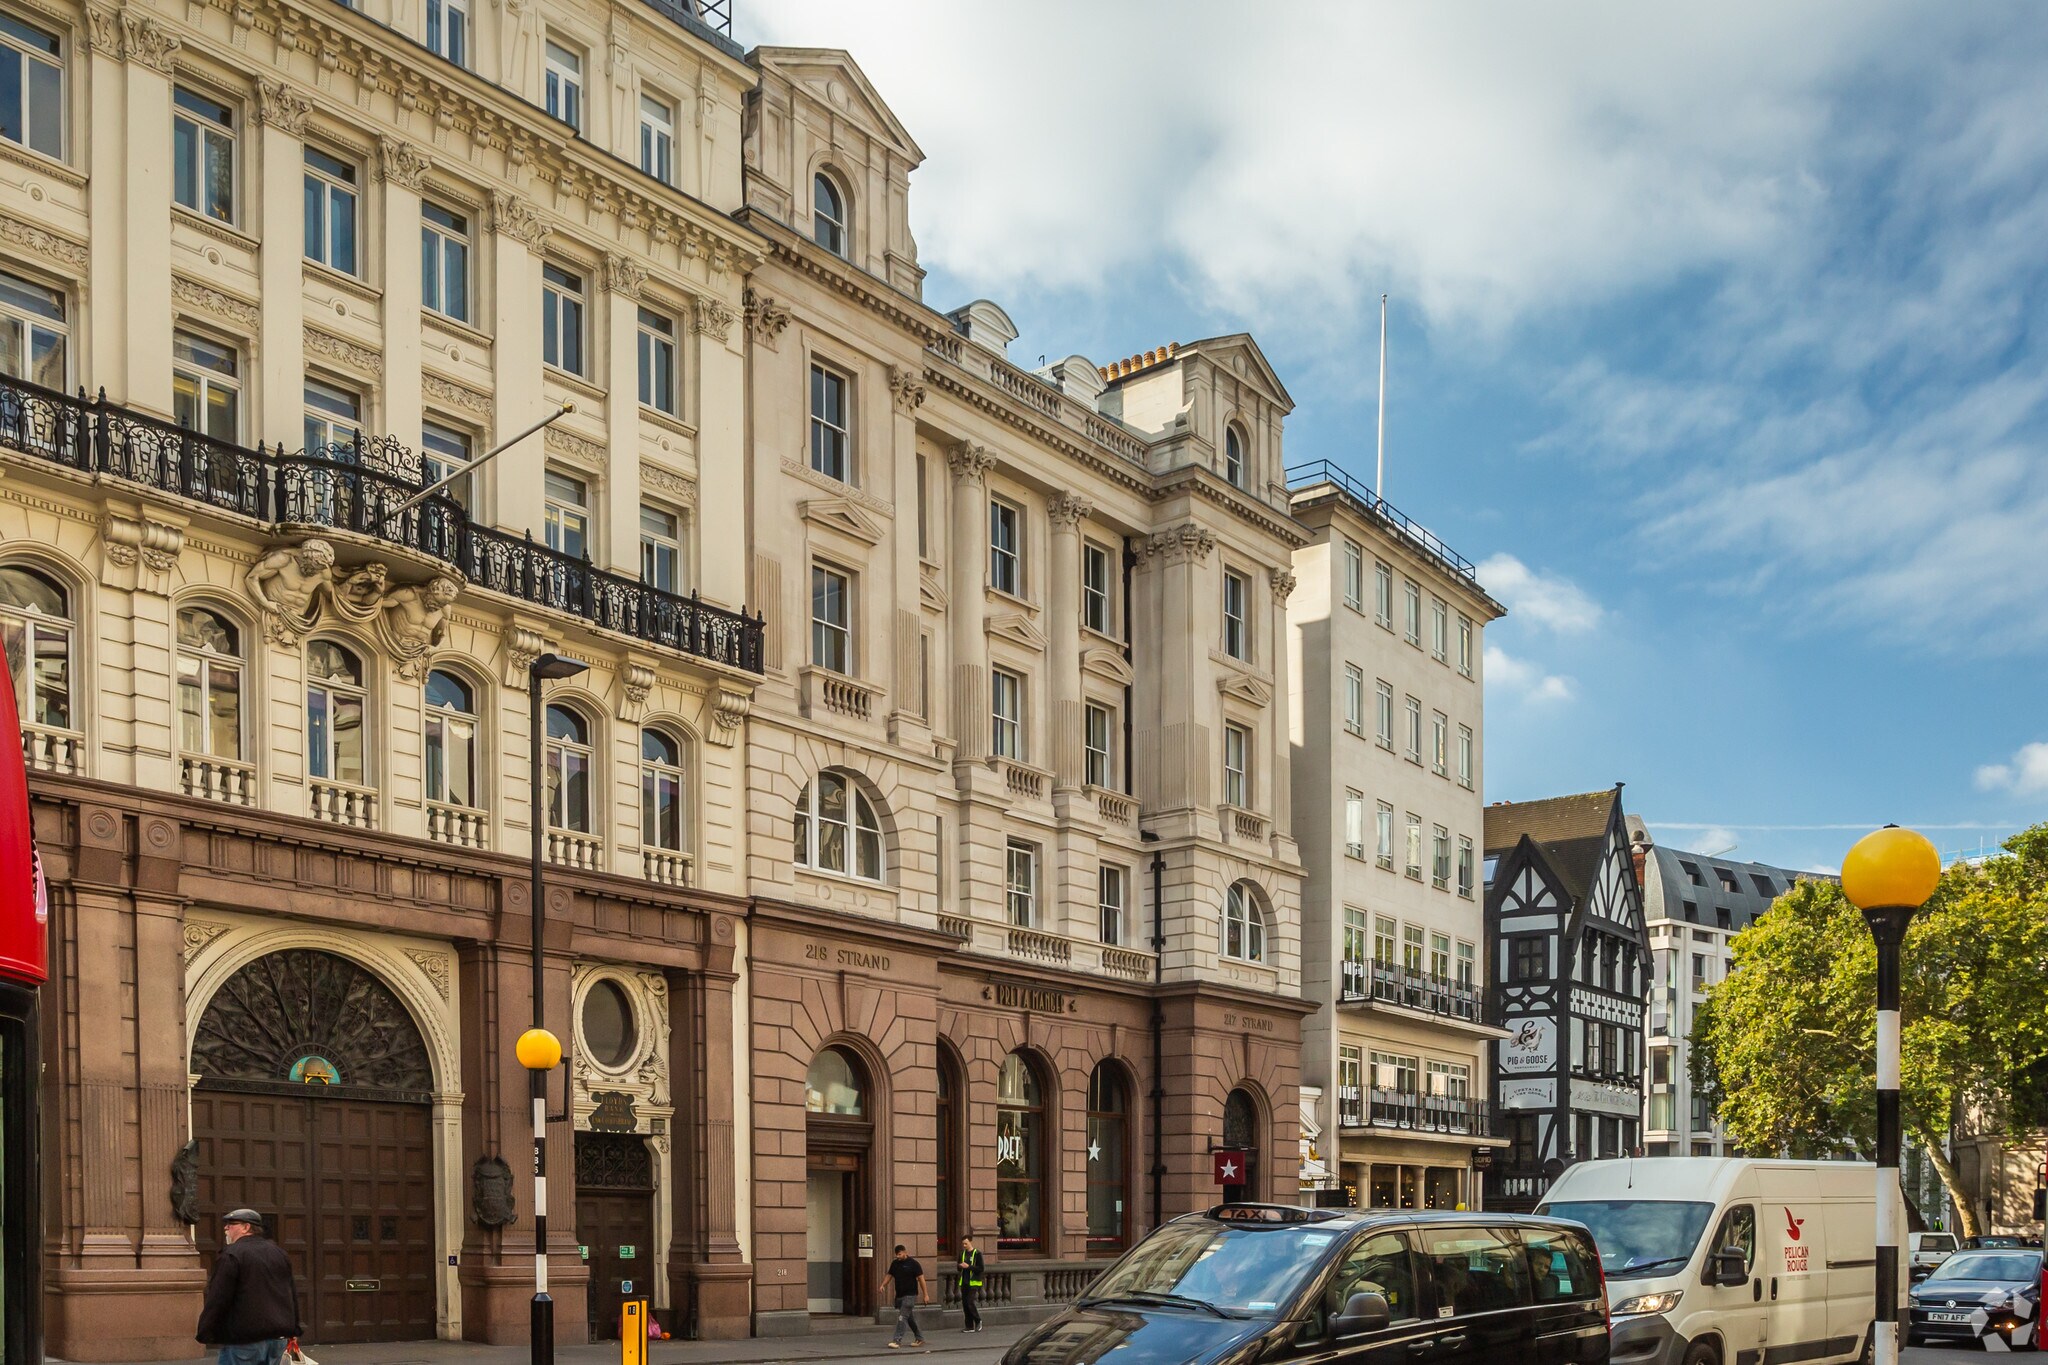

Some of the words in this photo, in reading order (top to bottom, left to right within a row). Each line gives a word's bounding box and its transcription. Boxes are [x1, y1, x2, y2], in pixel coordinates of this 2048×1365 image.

[805, 944, 827, 961] 218
[837, 949, 890, 971] STRAND
[1242, 1016, 1273, 1032] STRAND
[1507, 1056, 1519, 1065] PIG
[1525, 1055, 1548, 1065] GOOSE
[998, 1135, 1021, 1161] PRET
[1229, 1209, 1268, 1219] TAXI
[1784, 1246, 1809, 1259] PELICAN
[1787, 1259, 1808, 1272] ROUGE
